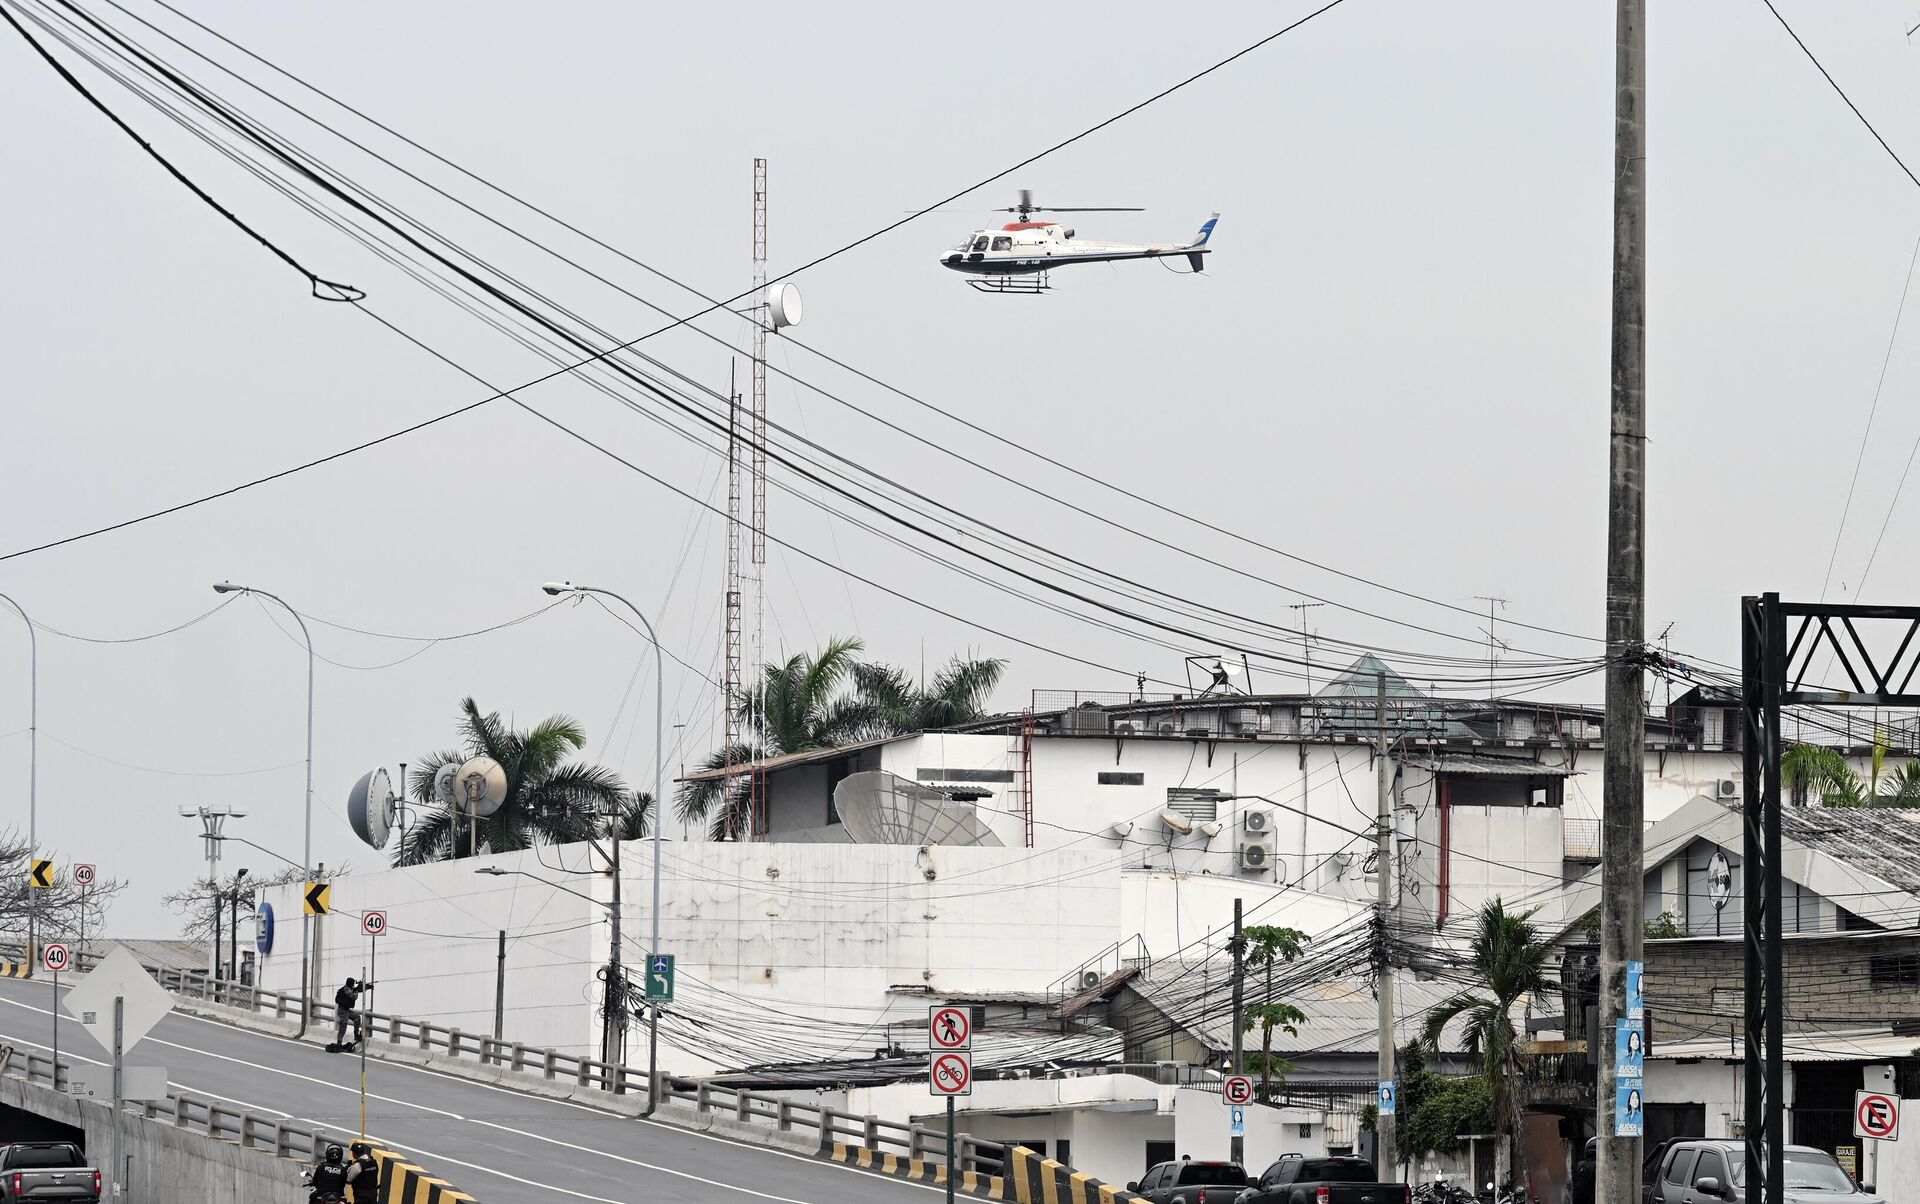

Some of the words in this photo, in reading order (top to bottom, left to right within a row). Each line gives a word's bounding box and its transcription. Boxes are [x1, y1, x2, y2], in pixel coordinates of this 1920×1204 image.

[78, 870, 91, 880] 40
[367, 917, 382, 929] 40
[49, 950, 64, 963] 40
[1868, 1102, 1888, 1129] E
